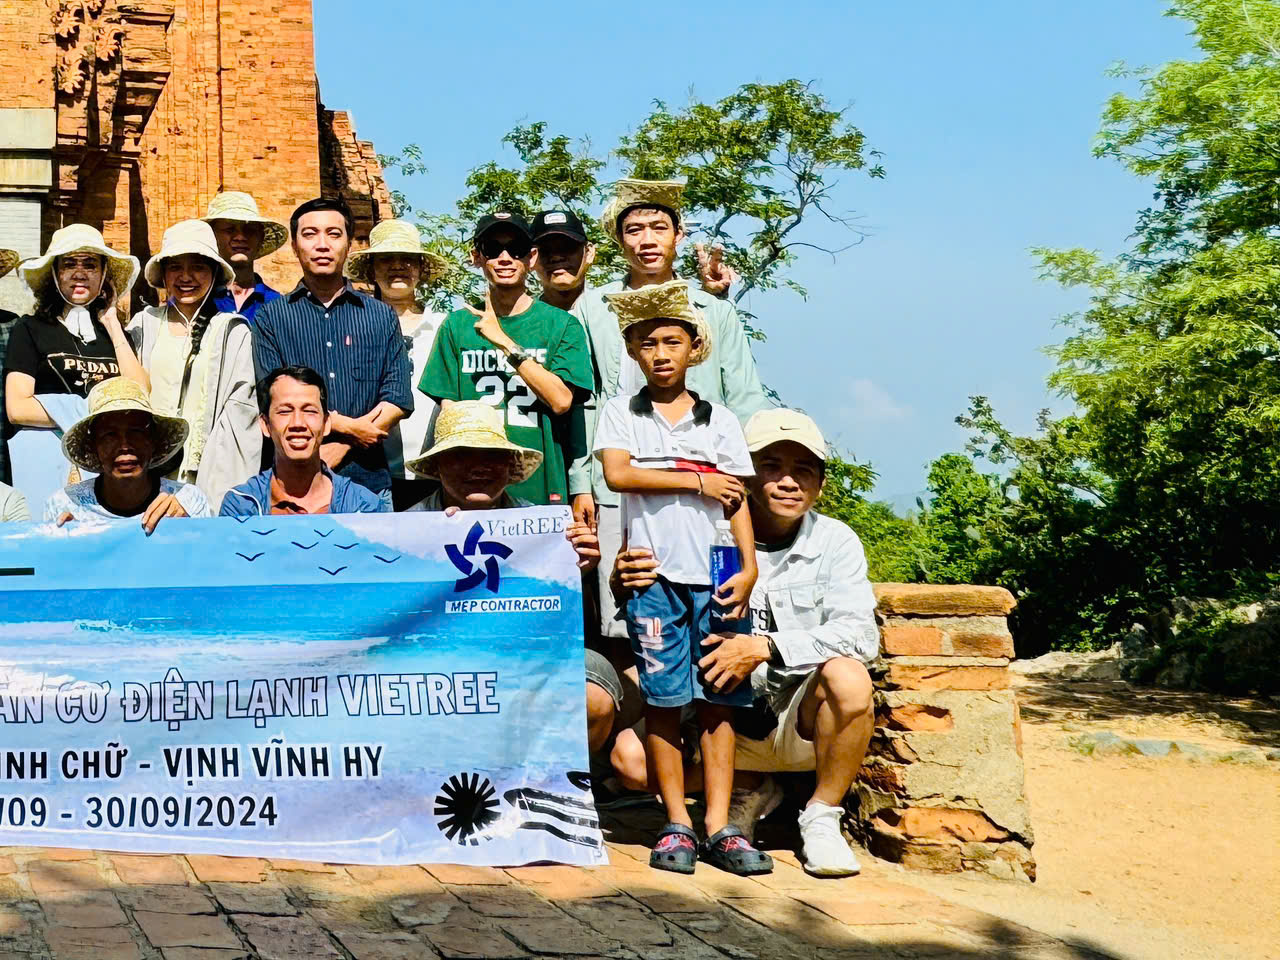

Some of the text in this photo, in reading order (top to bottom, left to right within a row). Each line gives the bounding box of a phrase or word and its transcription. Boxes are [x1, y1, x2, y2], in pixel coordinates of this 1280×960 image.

[476, 375, 538, 427] 22
[451, 599, 560, 613] MEP CONTRACTOR
[634, 616, 665, 674] FILA
[55, 680, 111, 724] CƠ
[120, 667, 214, 731] ĐIỆN
[226, 676, 328, 728] LẠNH
[337, 671, 500, 717] VIETREE
[61, 743, 128, 780] CHỮ
[163, 747, 240, 787] VỊNH
[252, 738, 330, 777] VĨNH
[344, 745, 383, 777] HY
[86, 796, 278, 828] 30/09/2024
